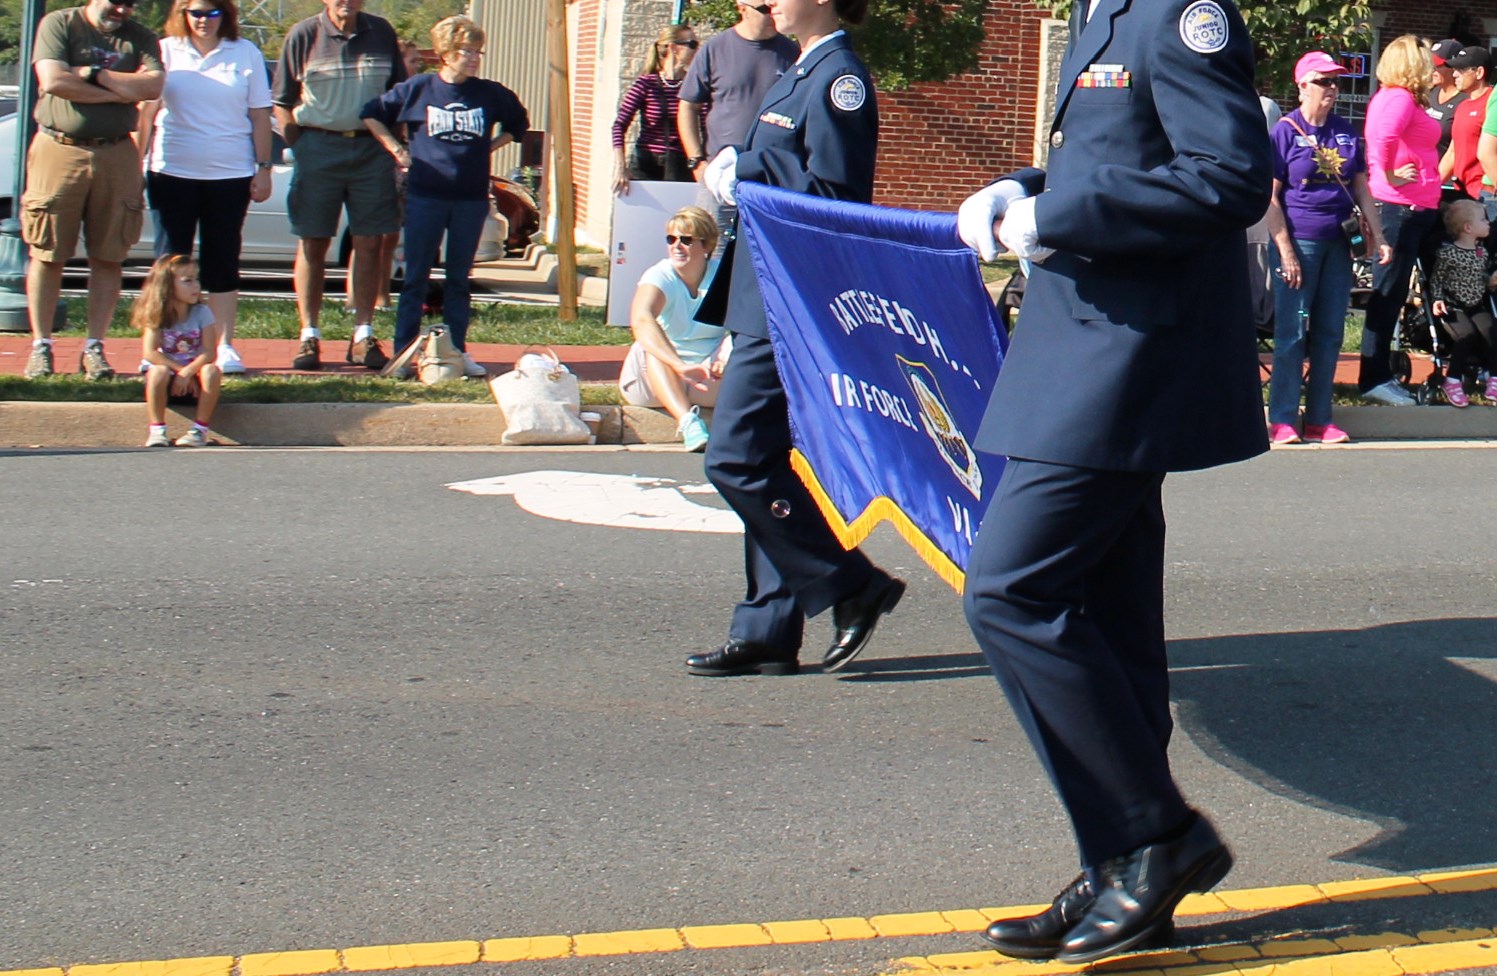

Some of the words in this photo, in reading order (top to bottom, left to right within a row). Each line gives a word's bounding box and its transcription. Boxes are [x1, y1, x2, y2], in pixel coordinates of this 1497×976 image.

[1187, 11, 1197, 24] AIR
[1198, 7, 1219, 19] FORCE
[1194, 21, 1219, 32] JUNIOR
[1193, 27, 1223, 41] ROTC
[838, 94, 860, 102] ROTC
[427, 105, 454, 137] PENN
[455, 106, 484, 137] STATE
